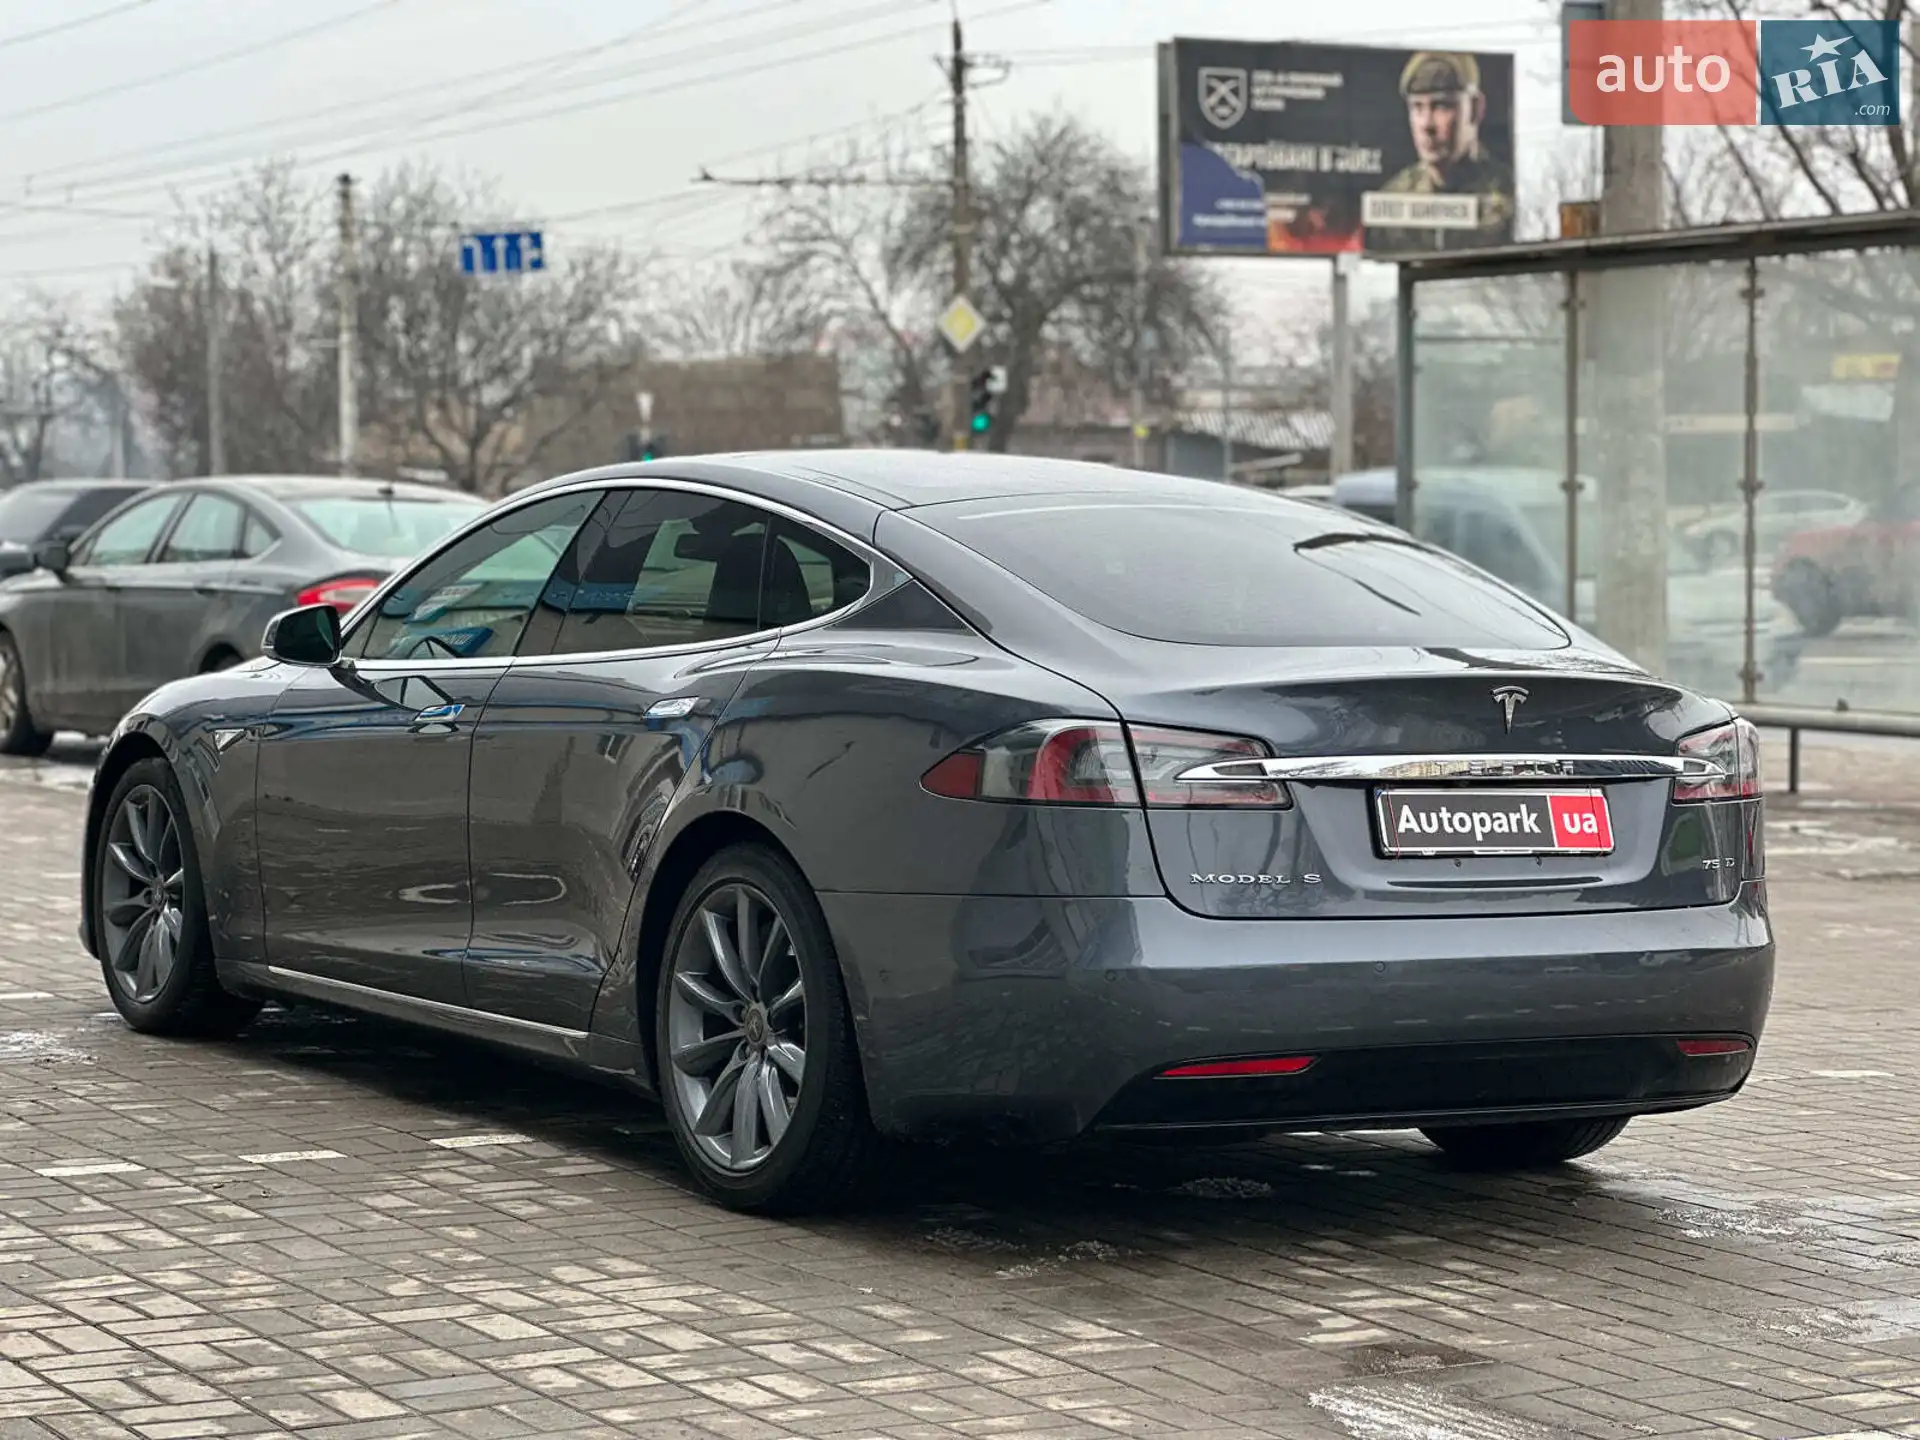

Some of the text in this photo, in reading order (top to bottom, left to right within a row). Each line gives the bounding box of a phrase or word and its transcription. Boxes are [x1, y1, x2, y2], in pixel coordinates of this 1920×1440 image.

[1397, 803, 1599, 842] Autopark ua
[1190, 873, 1322, 884] MODEL S
